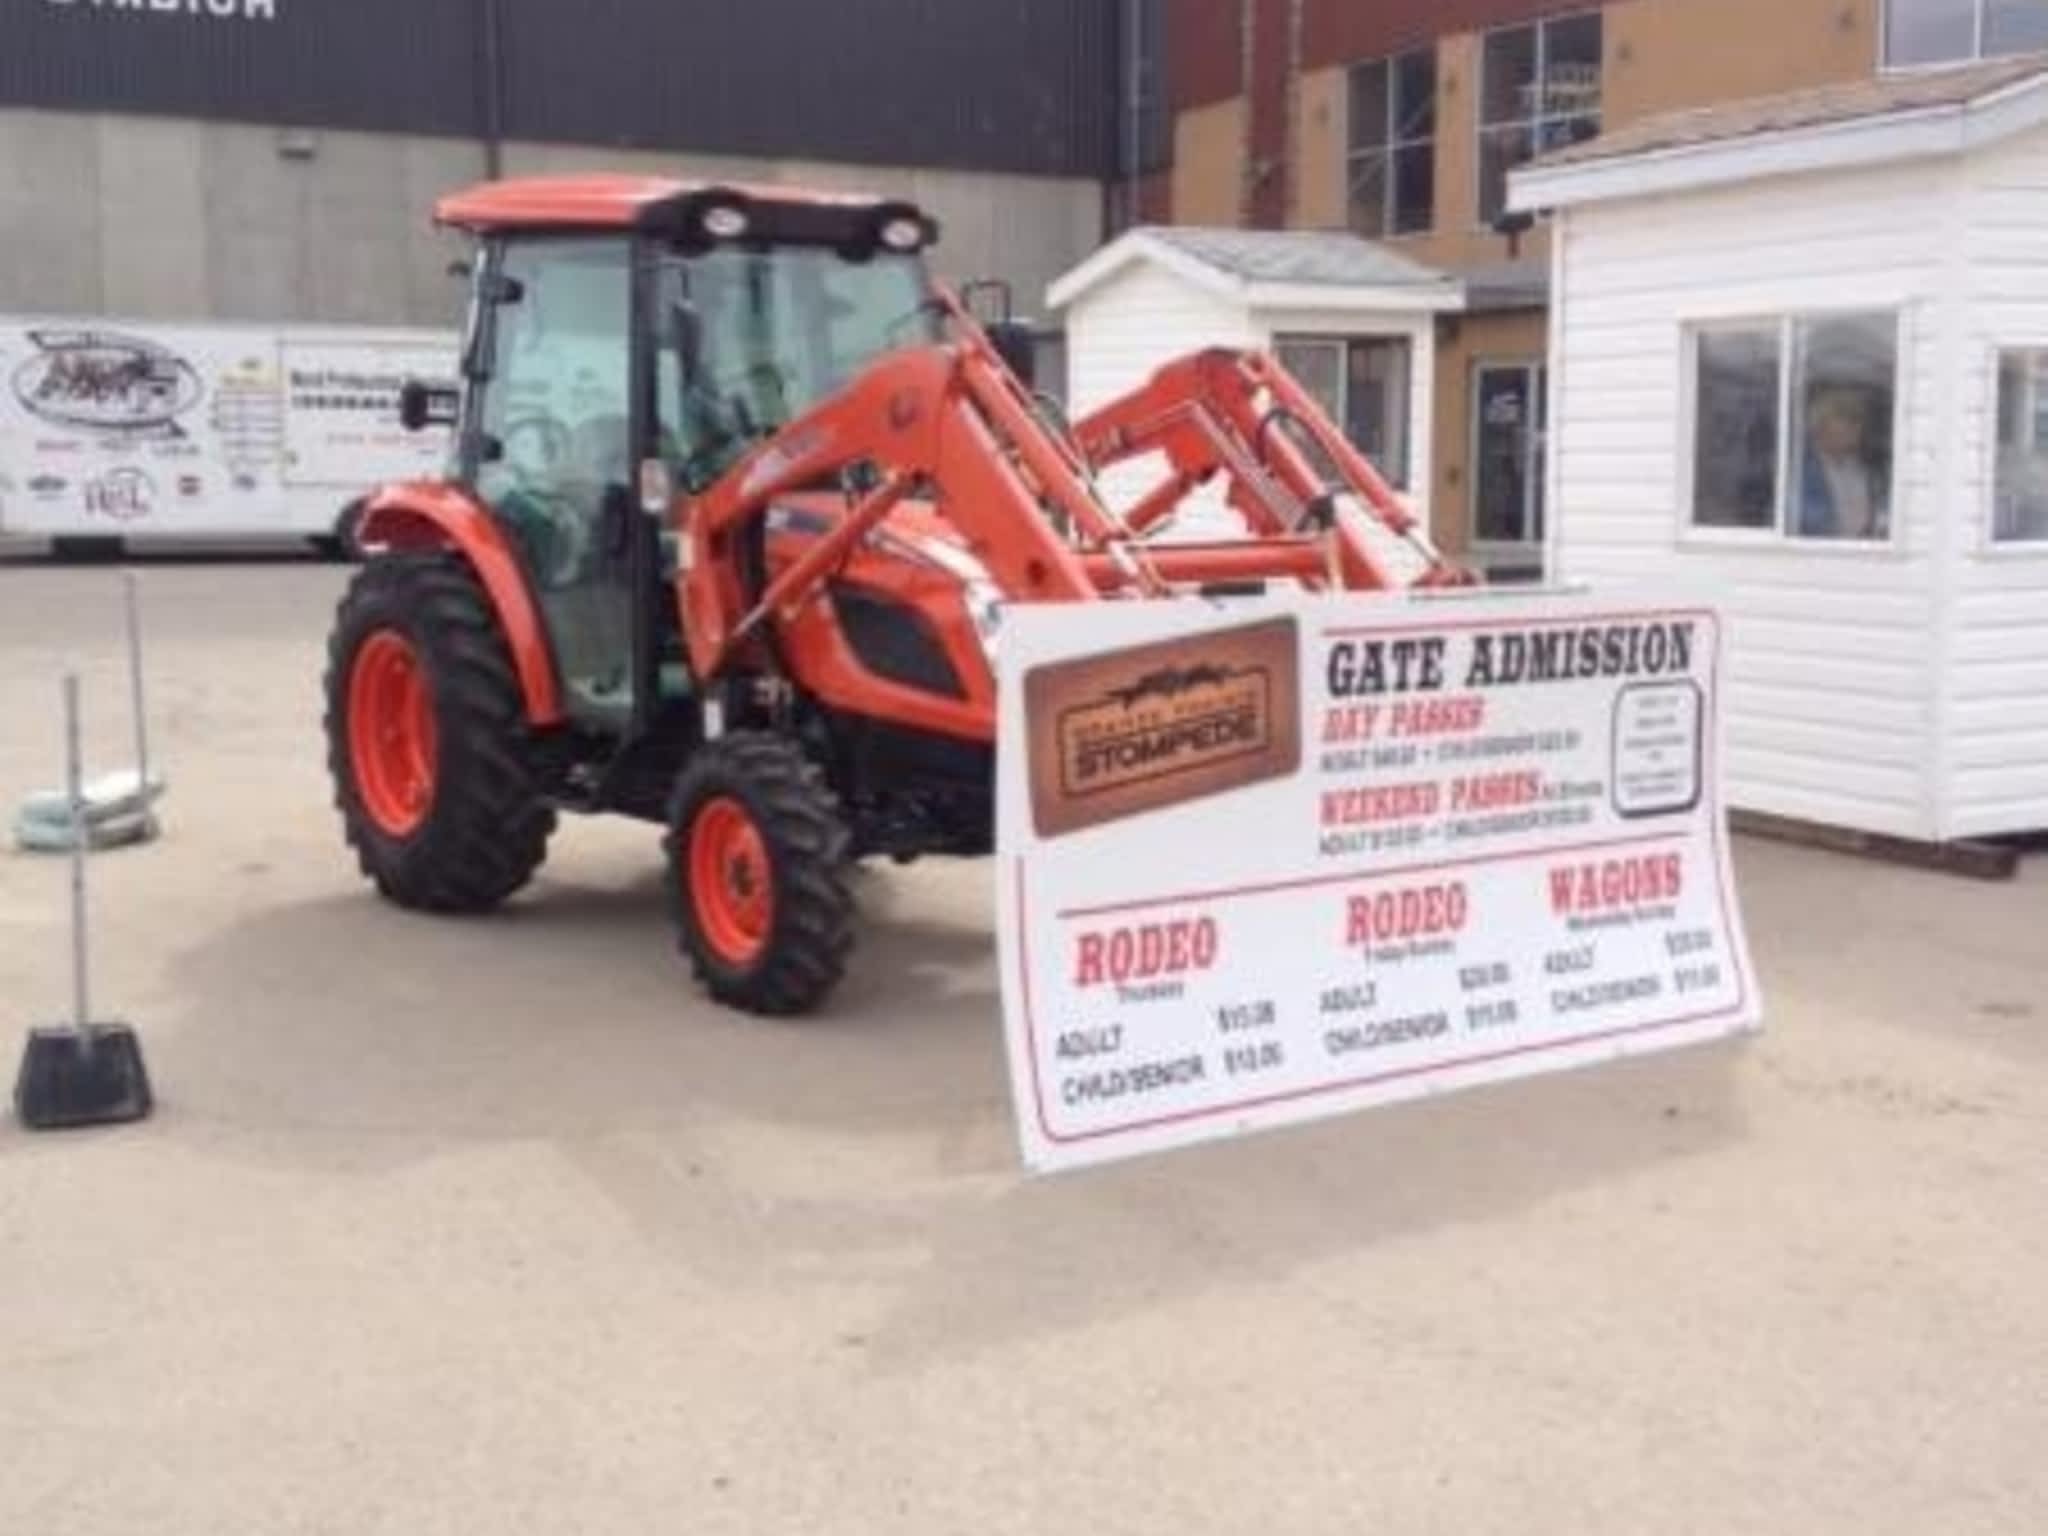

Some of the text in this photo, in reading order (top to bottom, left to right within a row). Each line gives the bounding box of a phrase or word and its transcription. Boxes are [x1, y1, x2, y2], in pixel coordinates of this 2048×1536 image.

[1327, 623, 1695, 696] GATE ADMISSION
[1078, 710, 1257, 780] STOMPEDE
[1322, 697, 1485, 742] DAY PASSES
[1320, 782, 1439, 825] WEEKEND
[1451, 770, 1542, 811] PASSES
[1549, 855, 1682, 914] WAGONS
[1346, 883, 1468, 945] RODEO
[1074, 918, 1218, 988] RODEO
[1319, 981, 1376, 1013] ADULT
[1056, 1024, 1123, 1058] ADULT
[1061, 1056, 1206, 1106] CHILD/SENIOR
